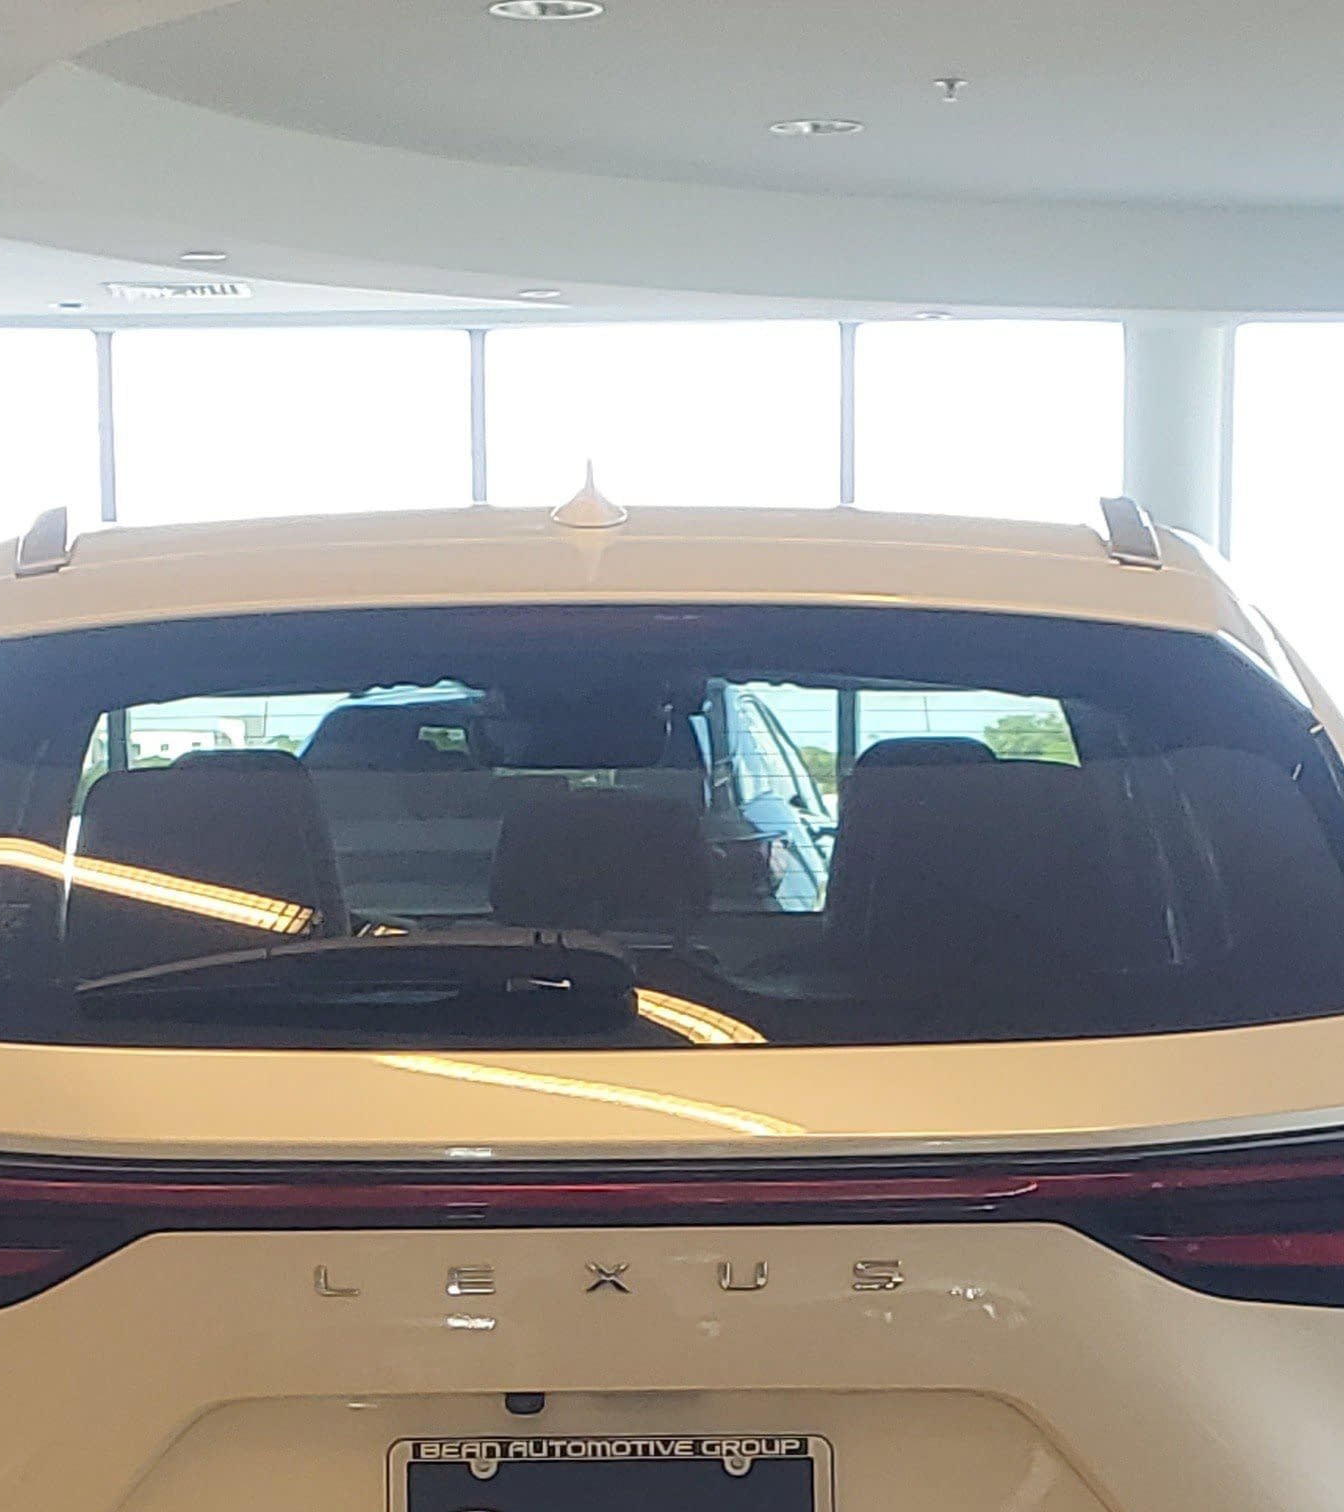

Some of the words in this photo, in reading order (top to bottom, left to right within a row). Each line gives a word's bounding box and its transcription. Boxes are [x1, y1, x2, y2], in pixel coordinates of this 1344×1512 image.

[313, 1259, 904, 1298] LEXUS
[420, 1442, 502, 1460] BEAN
[508, 1439, 695, 1458] AUTOMOTIVE
[701, 1438, 801, 1457] GROUP
